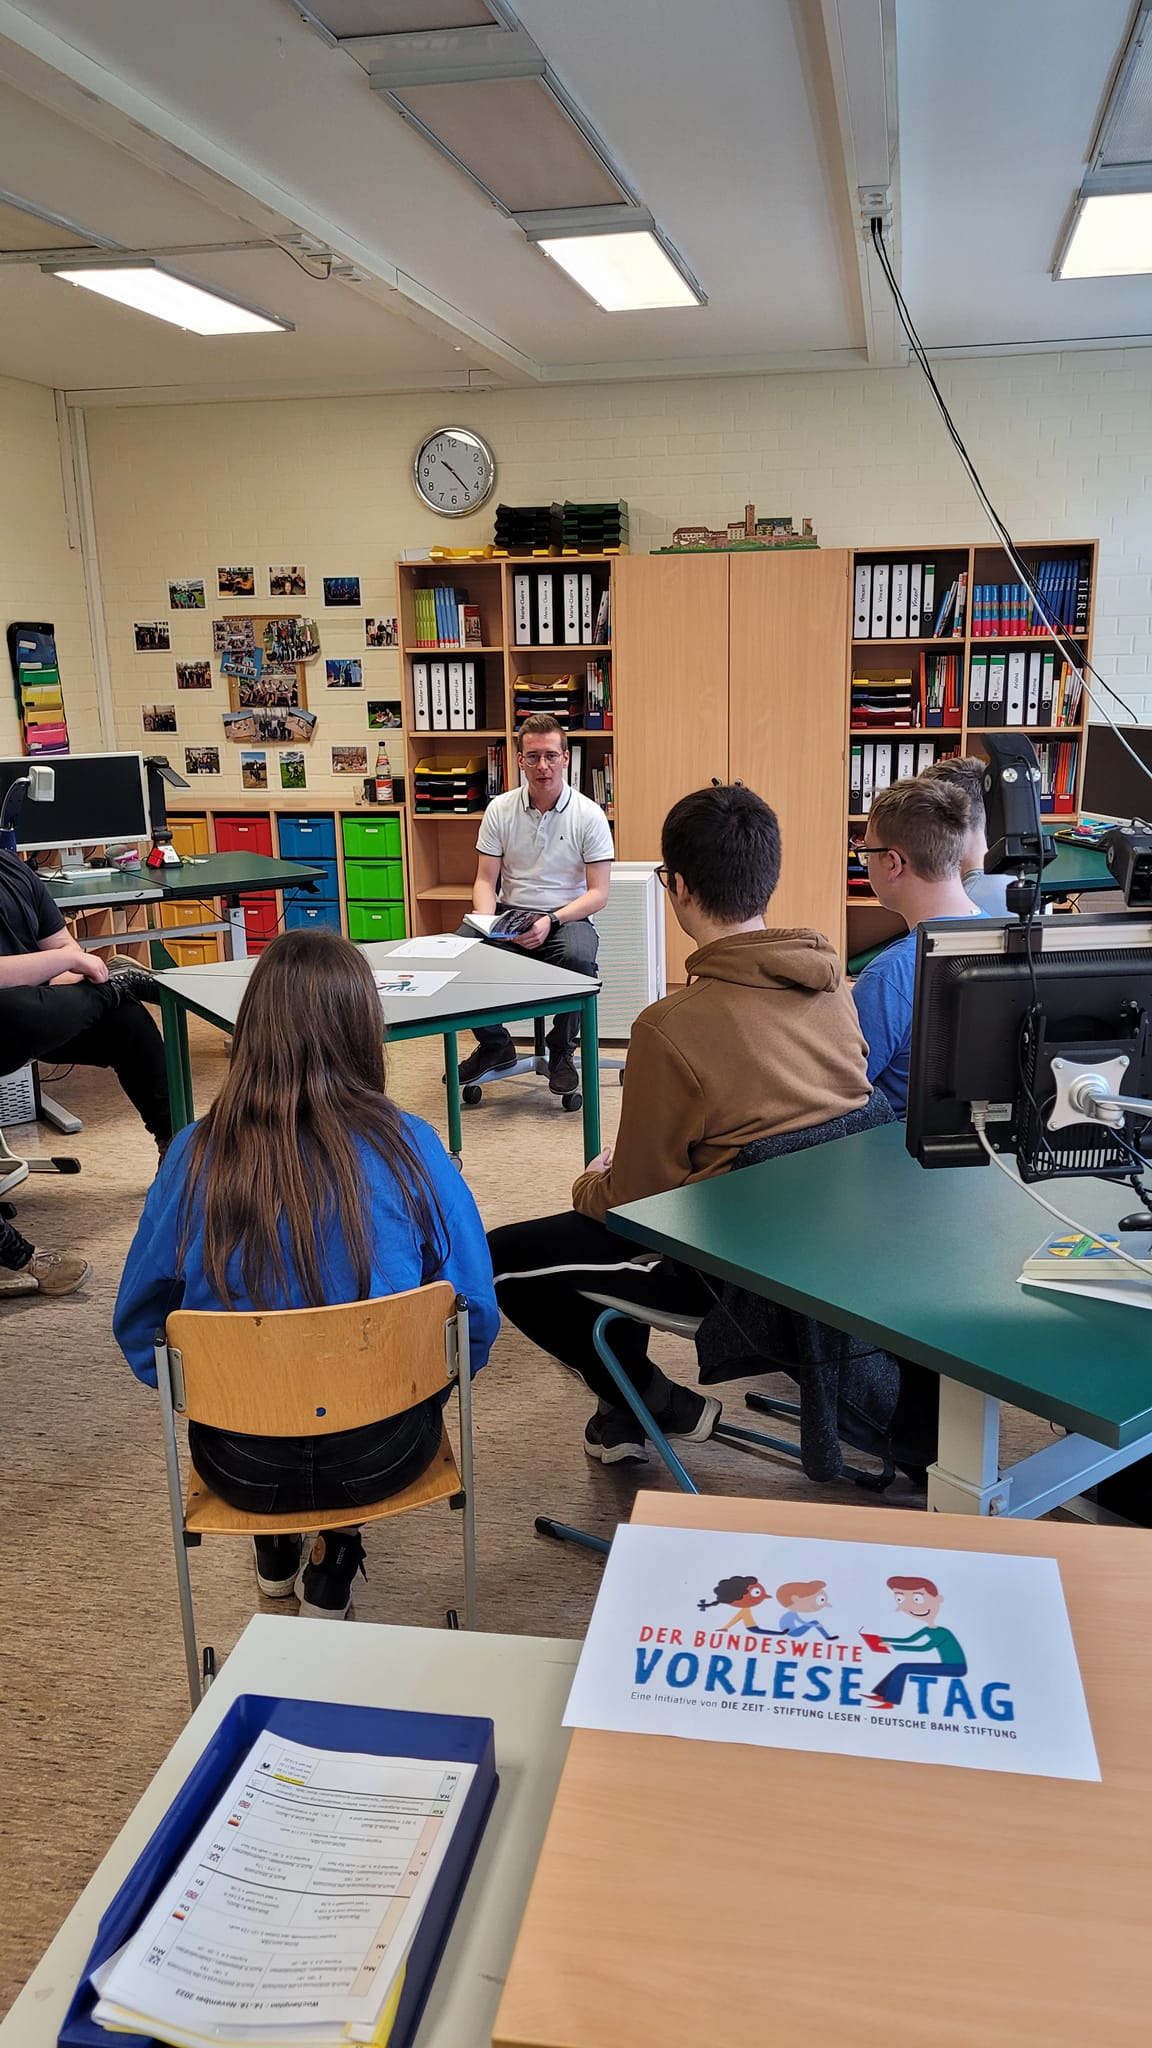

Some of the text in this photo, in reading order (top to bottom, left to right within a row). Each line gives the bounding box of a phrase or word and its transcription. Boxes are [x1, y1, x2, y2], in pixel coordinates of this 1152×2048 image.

[436, 443, 443, 452] 11
[447, 439, 457, 448] 12
[465, 443, 469, 452] 1
[426, 454, 436, 463] 10
[473, 453, 479, 462] 2
[423, 468, 430, 477] 9
[477, 467, 483, 475] 3
[428, 482, 434, 491] 8
[473, 481, 479, 489] 4
[439, 492, 444, 501] 7
[451, 496, 457, 504] 6
[464, 492, 470, 501] 5
[1076, 577, 1088, 619] TIERE
[639, 1625, 864, 1662] DER BUNDESWEITE
[634, 1647, 1014, 1722] VORLESE TAG
[631, 1691, 1017, 1739] Eine Initiative von DIE ZEIT STIFTUNG LESEN DEUTSCHE BAHN STIFTUNG
[232, 1813, 242, 1821] De
[194, 1878, 205, 1887] En
[179, 1903, 190, 1912] De
[196, 1996, 237, 2008] November
